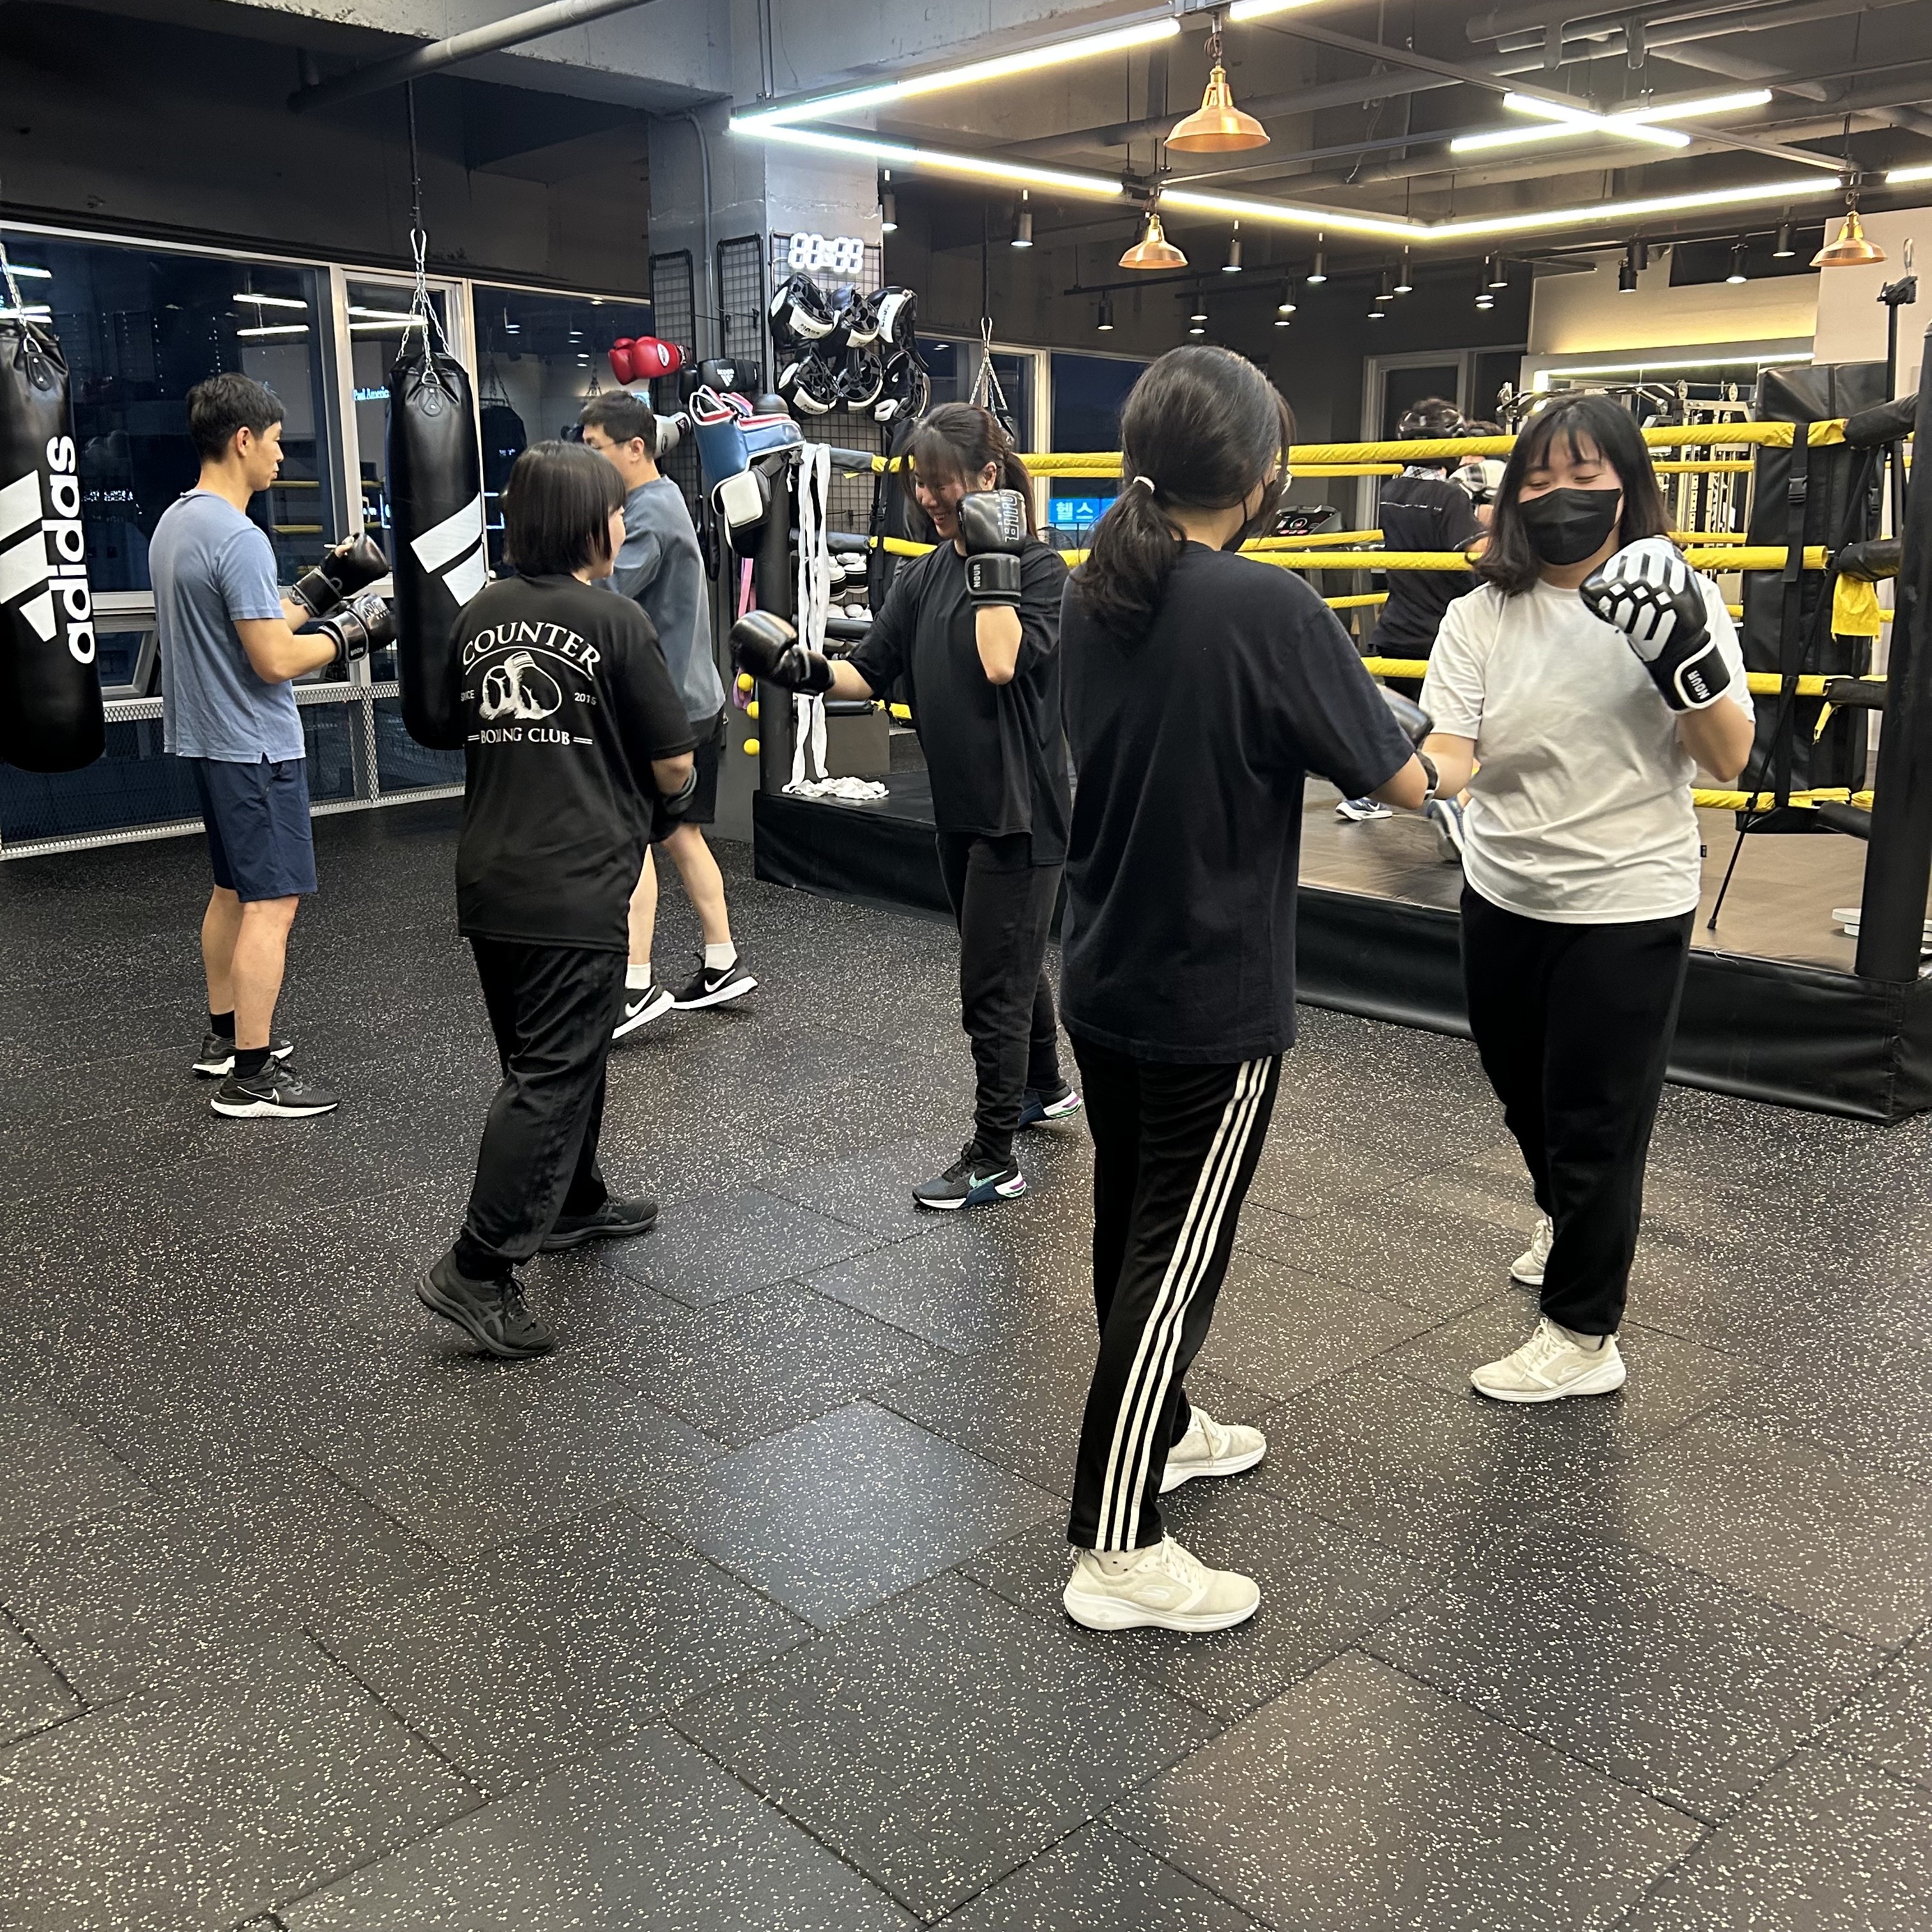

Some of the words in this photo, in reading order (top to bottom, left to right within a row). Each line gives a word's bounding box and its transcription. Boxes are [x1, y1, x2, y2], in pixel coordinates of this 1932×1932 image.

[1055, 502, 1094, 521] 헬스
[42, 436, 96, 664] adidas
[973, 564, 981, 588] NOUR
[462, 620, 601, 677] COUNTER
[1687, 670, 1711, 699] NOUR
[574, 692, 597, 705] 2015
[527, 728, 571, 746] CLUB
